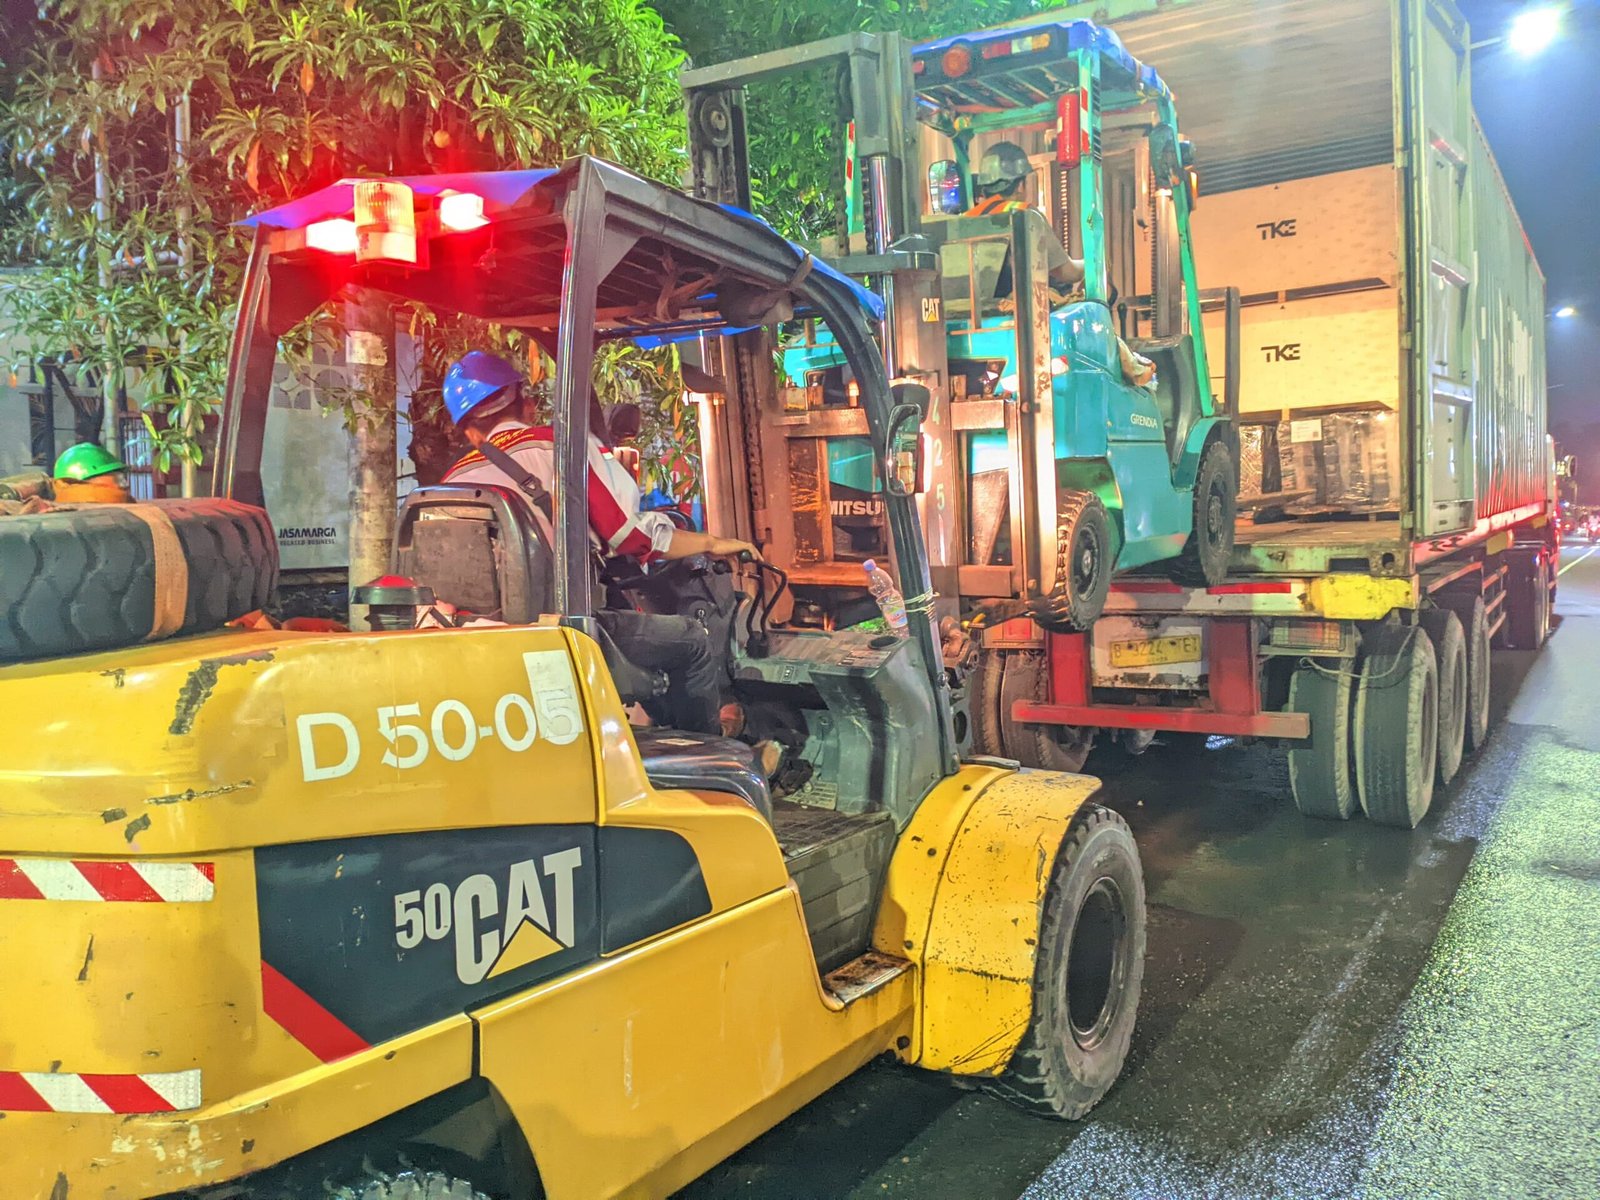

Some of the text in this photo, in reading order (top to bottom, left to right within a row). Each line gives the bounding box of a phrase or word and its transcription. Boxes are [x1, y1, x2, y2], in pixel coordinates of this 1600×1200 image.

[1256, 219, 1297, 240] TKE
[922, 298, 940, 322] CAT
[1260, 343, 1301, 363] TKE
[830, 500, 885, 516] MITSU
[278, 528, 336, 538] JASAMARGA
[296, 688, 582, 782] D 50-05
[394, 846, 583, 985] 50 CAT
